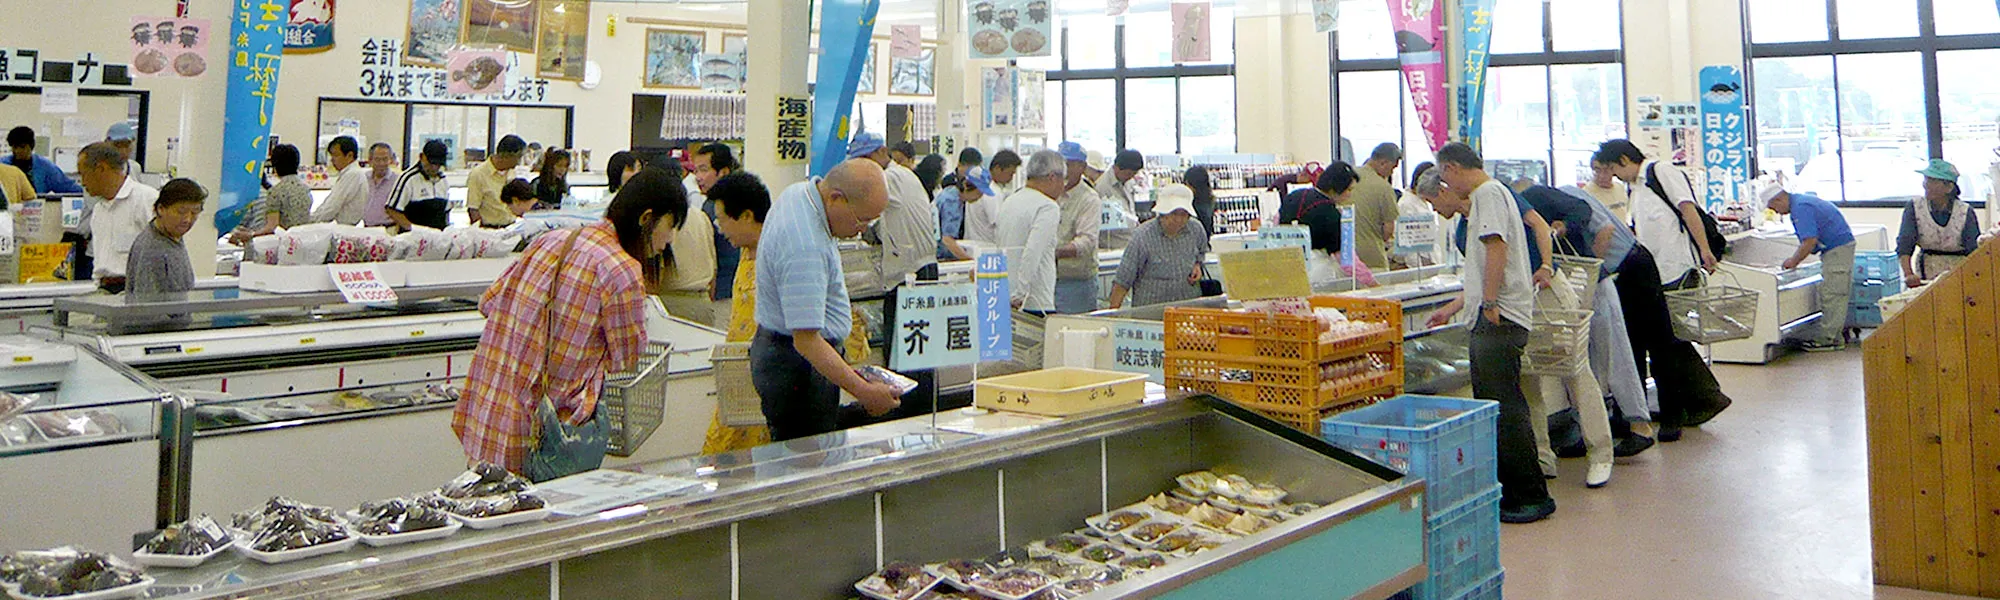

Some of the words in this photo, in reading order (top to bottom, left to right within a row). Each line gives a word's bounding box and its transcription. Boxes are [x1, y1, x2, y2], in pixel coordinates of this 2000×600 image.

[283, 27, 317, 46] 組合
[778, 97, 807, 160] 海産物
[982, 256, 1002, 270] JF
[982, 280, 1001, 349] JFグループ
[903, 315, 973, 356] 芥屋
